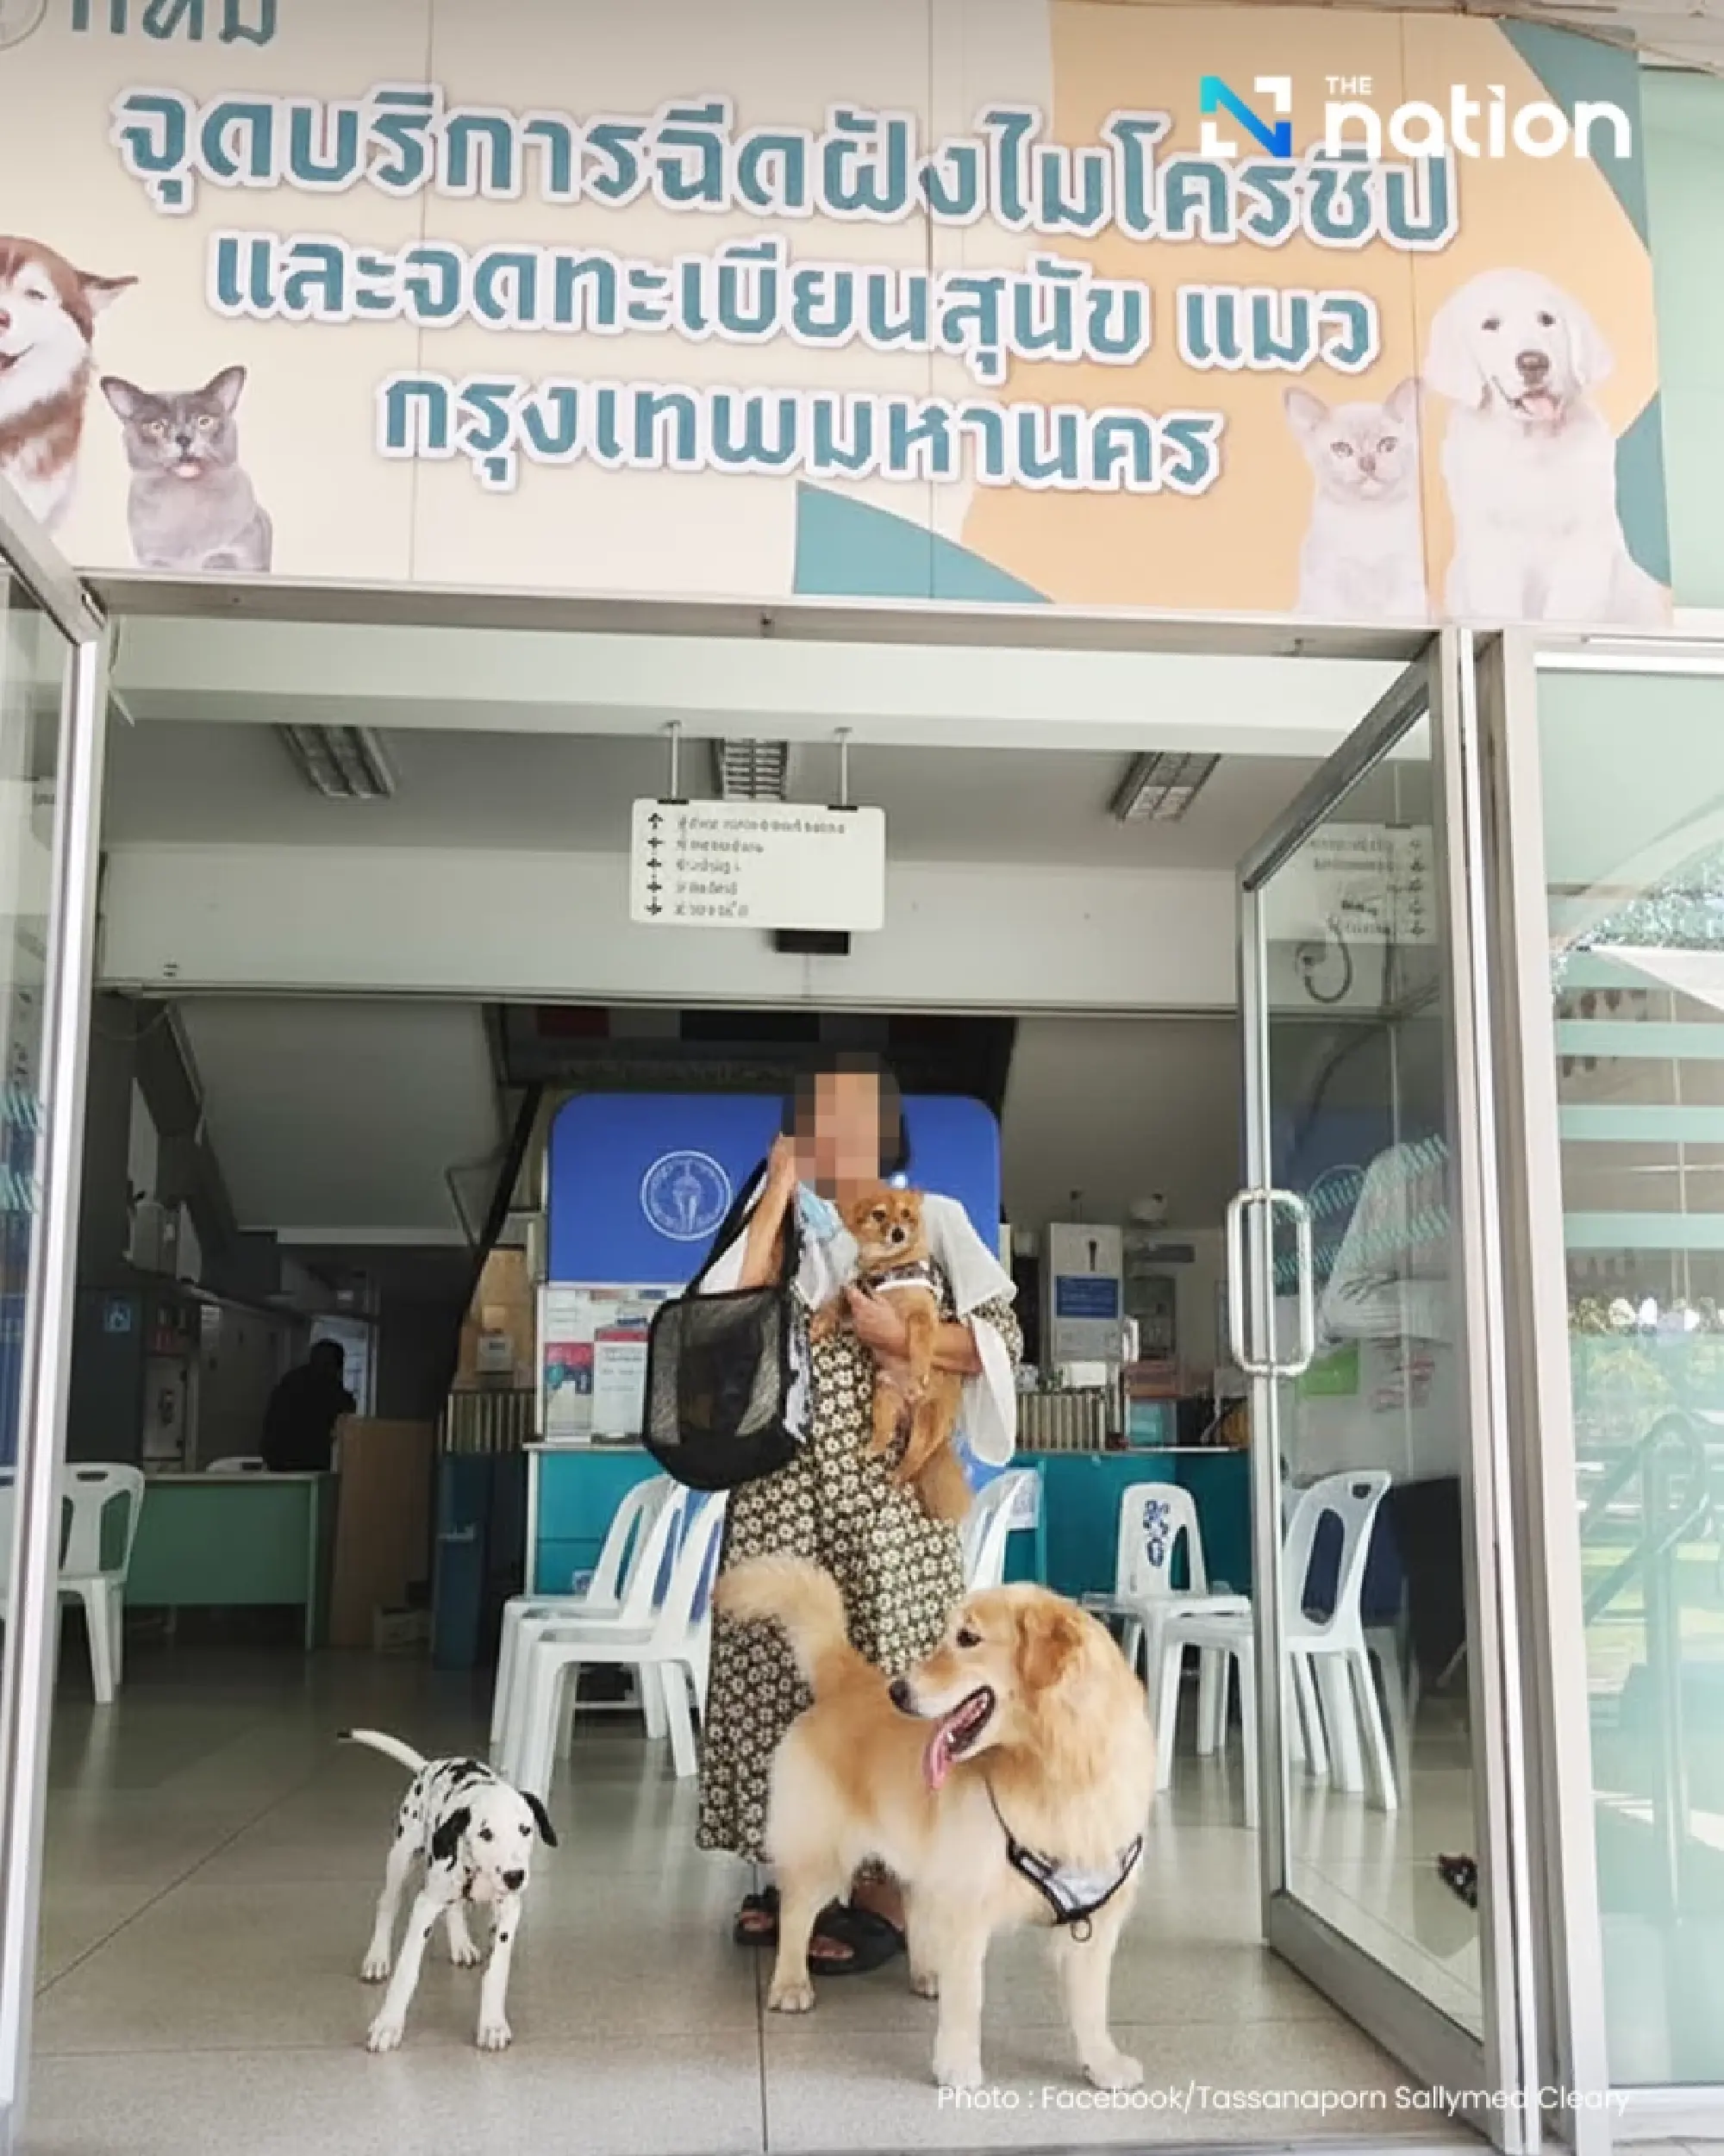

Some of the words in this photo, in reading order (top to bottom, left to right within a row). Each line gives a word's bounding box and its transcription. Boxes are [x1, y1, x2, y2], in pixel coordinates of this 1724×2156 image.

[116, 85, 1453, 246] จุดบริการฉีดฝังไมโครชิป
[213, 233, 1146, 379] และจดทะเบียนสุนัข
[1182, 288, 1376, 368] แมว
[380, 375, 1220, 491] กรุงเทพมหานคร
